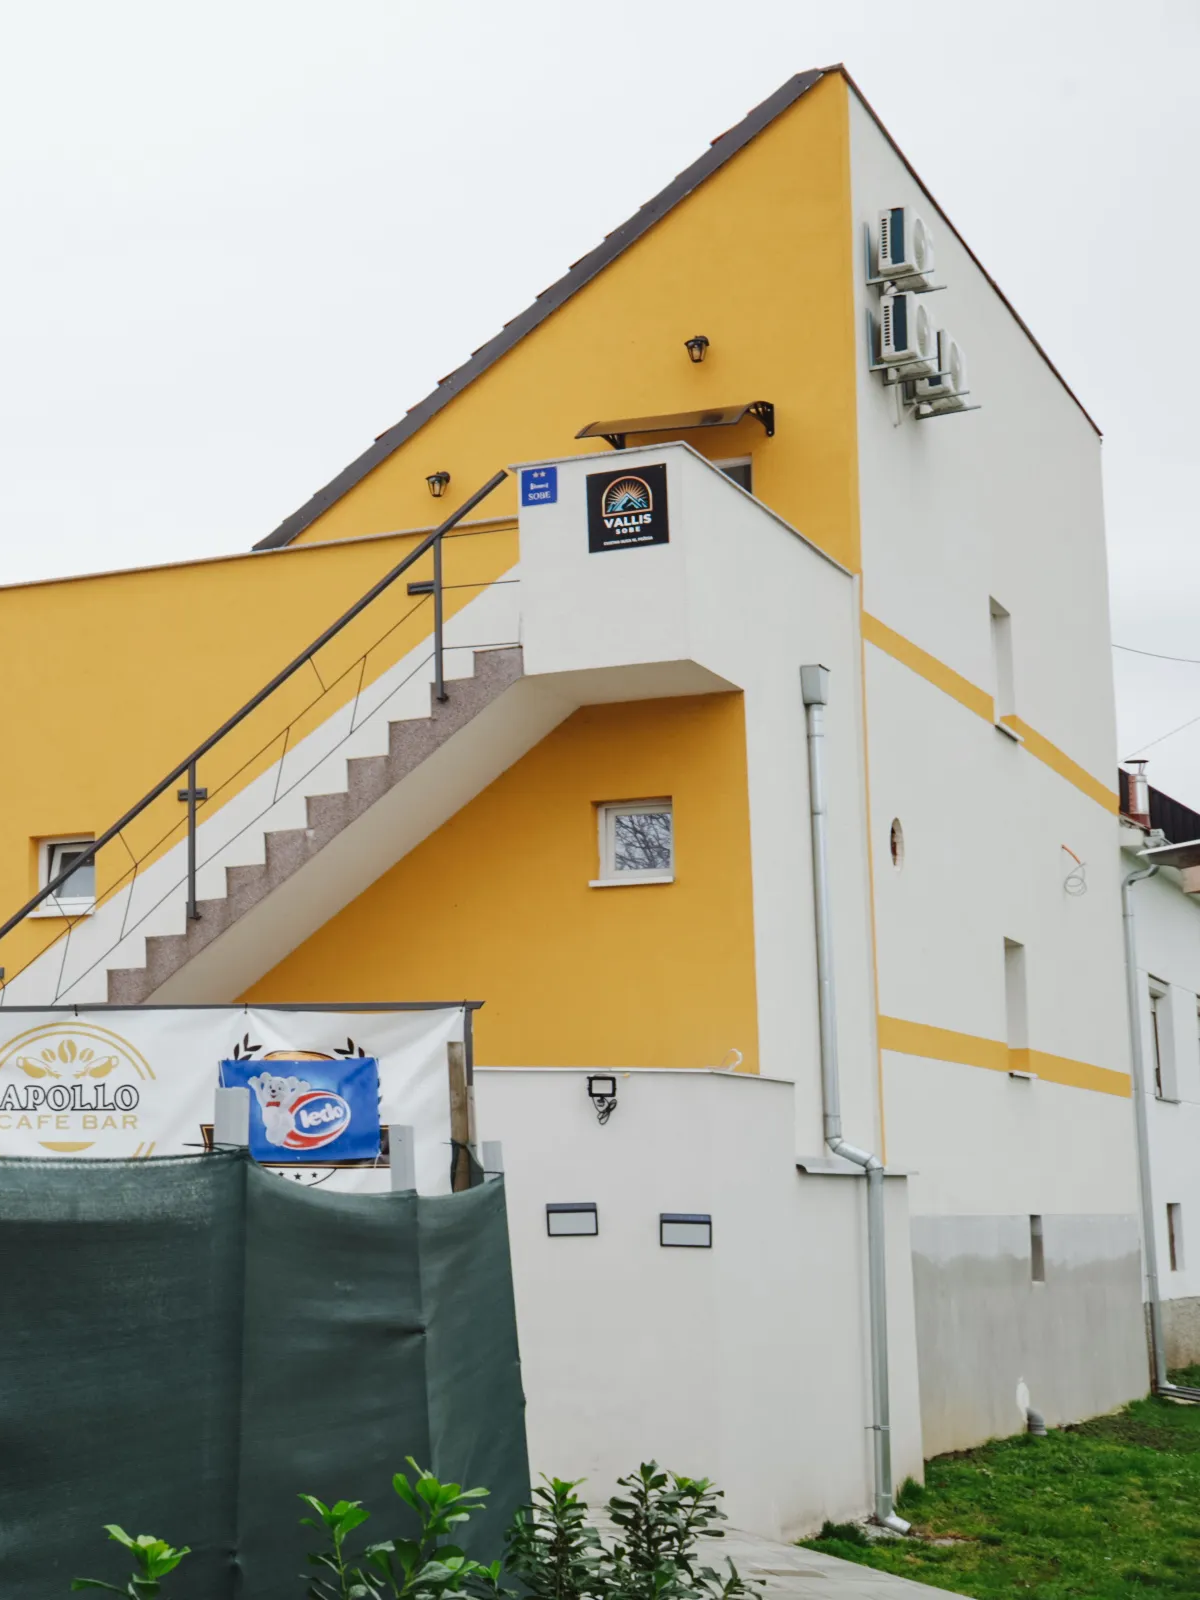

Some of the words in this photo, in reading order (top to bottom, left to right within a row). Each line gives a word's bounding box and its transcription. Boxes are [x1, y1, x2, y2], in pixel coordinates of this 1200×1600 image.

[528, 491, 551, 501] SOBE
[604, 513, 652, 528] VALLIS
[615, 526, 641, 535] SOBE
[82, 1115, 139, 1130] BAR
